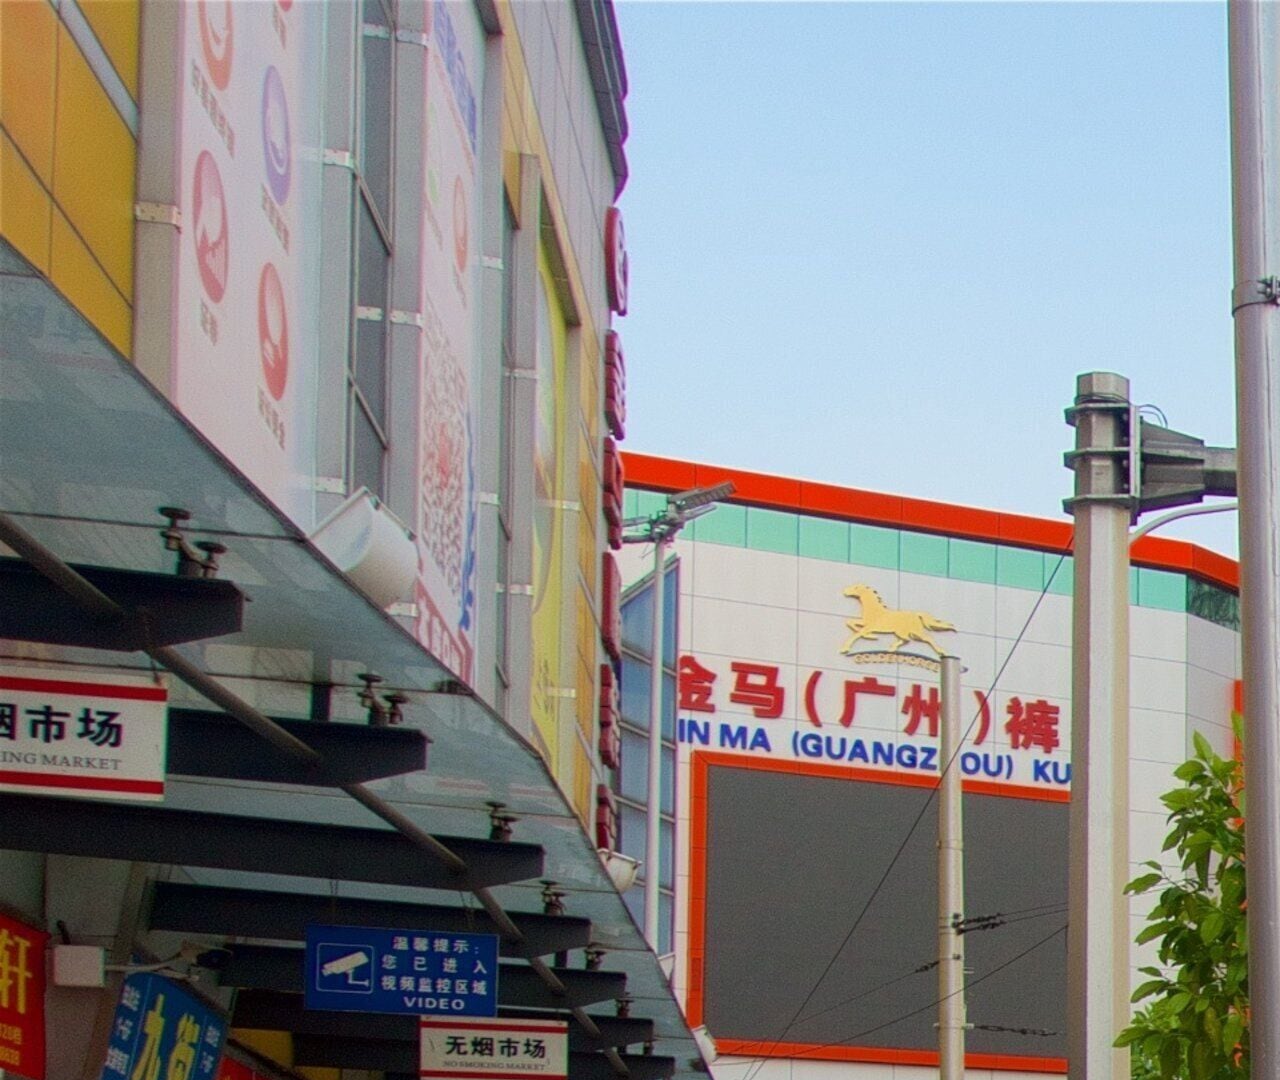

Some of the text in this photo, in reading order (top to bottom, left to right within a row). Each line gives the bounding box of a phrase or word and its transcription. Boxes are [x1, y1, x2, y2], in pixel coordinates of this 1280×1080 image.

[719, 724, 772, 752] MA
[42, 754, 122, 770] MARKET
[381, 954, 488, 975] 您已进入
[381, 975, 488, 996] 视频监控区域
[403, 996, 465, 1010] VIDEO
[445, 1035, 547, 1059] 无烟市场
